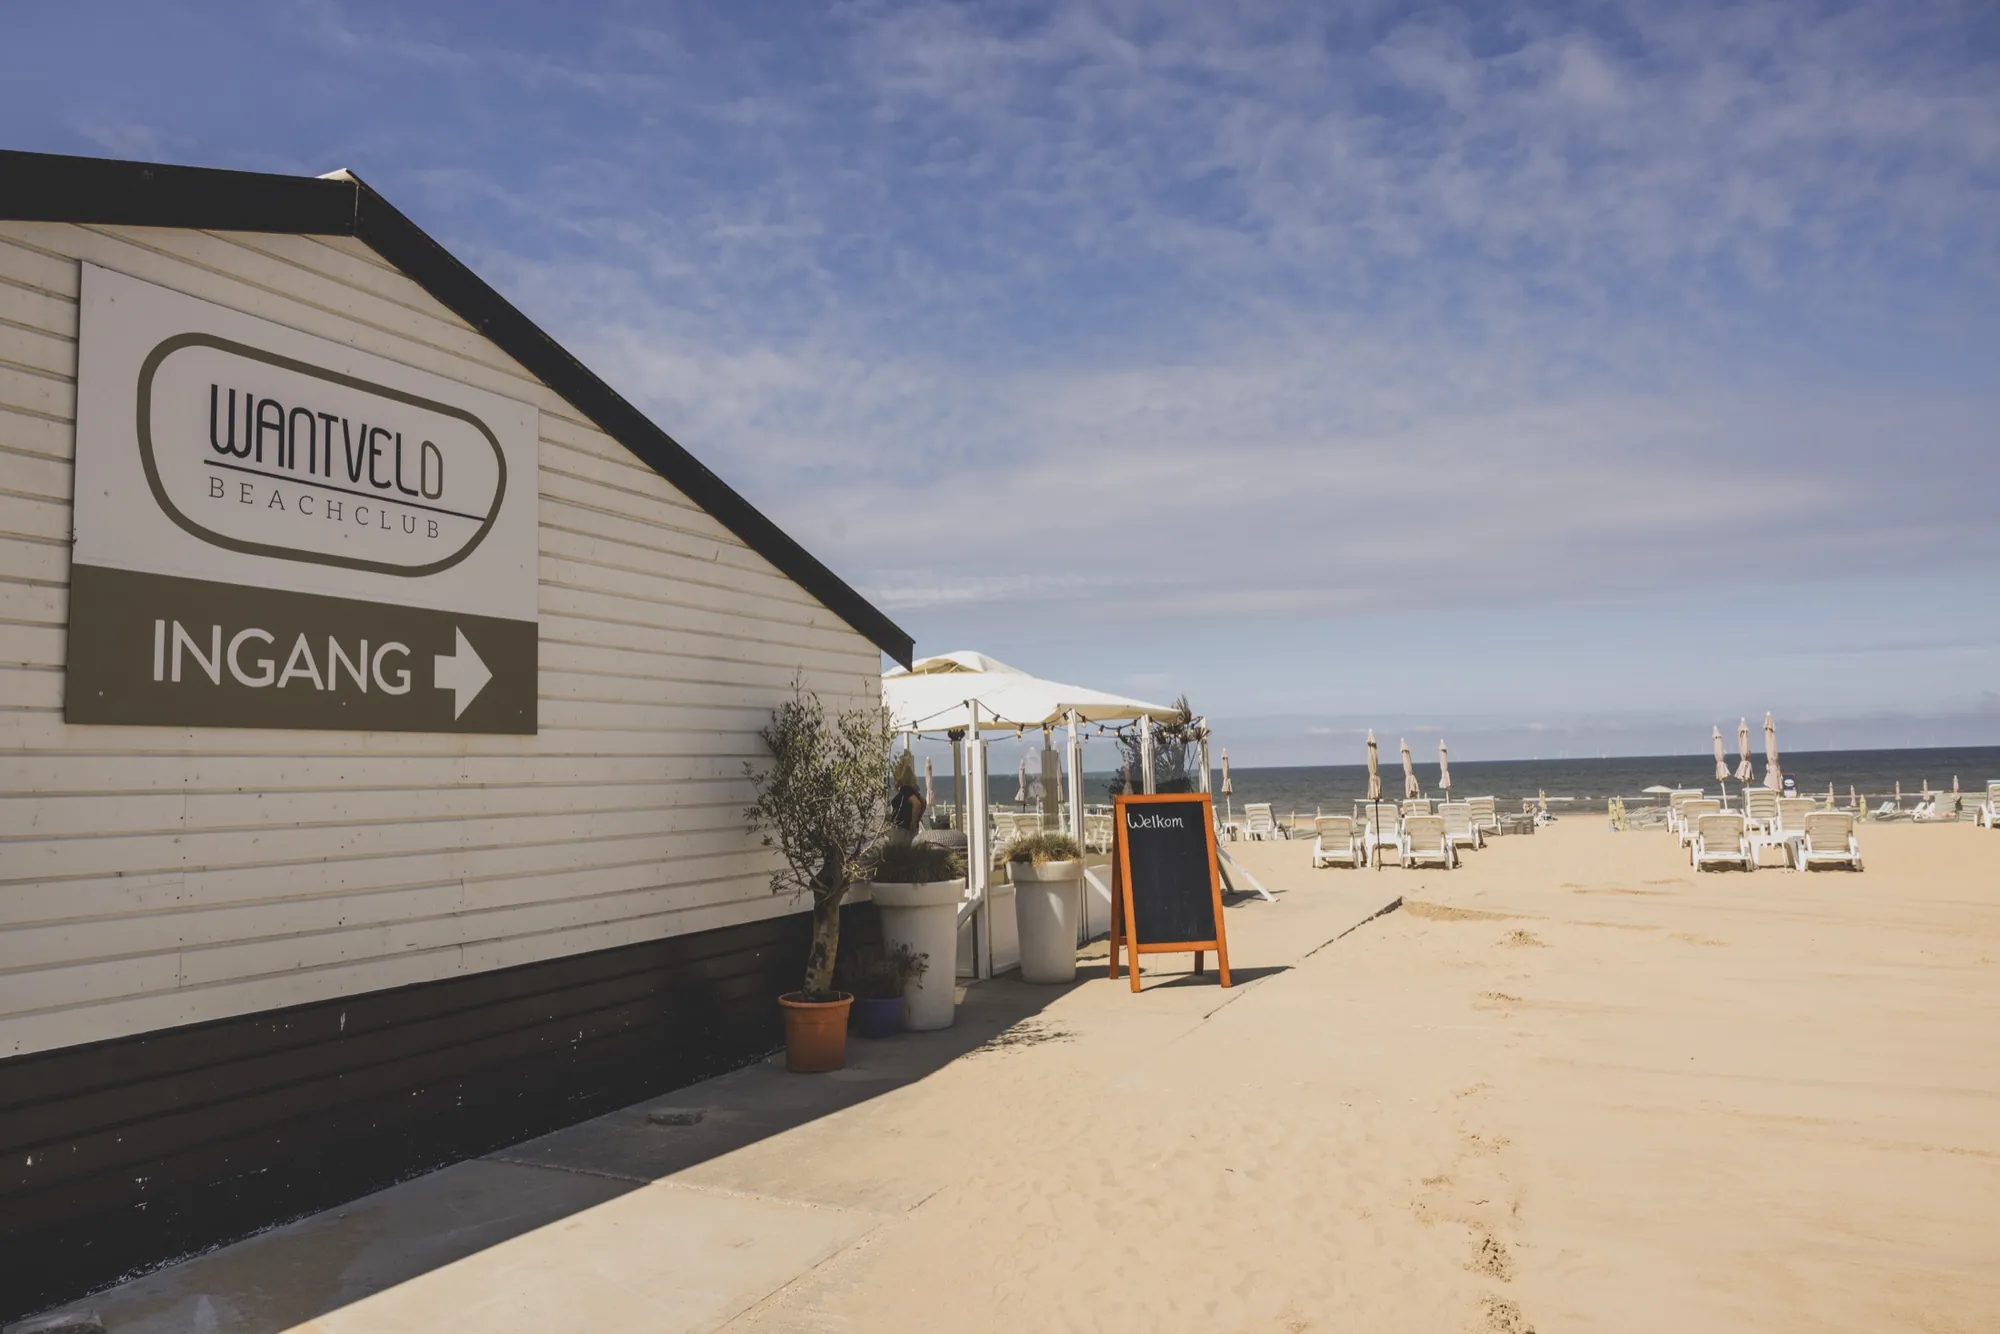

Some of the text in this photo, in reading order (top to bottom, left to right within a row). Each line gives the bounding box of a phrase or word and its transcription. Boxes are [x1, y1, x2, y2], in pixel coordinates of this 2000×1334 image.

[210, 384, 443, 500] WANTVELD
[209, 476, 439, 539] BEACHCLUB
[153, 619, 412, 696] INGANG
[1126, 812, 1184, 829] Welkom
